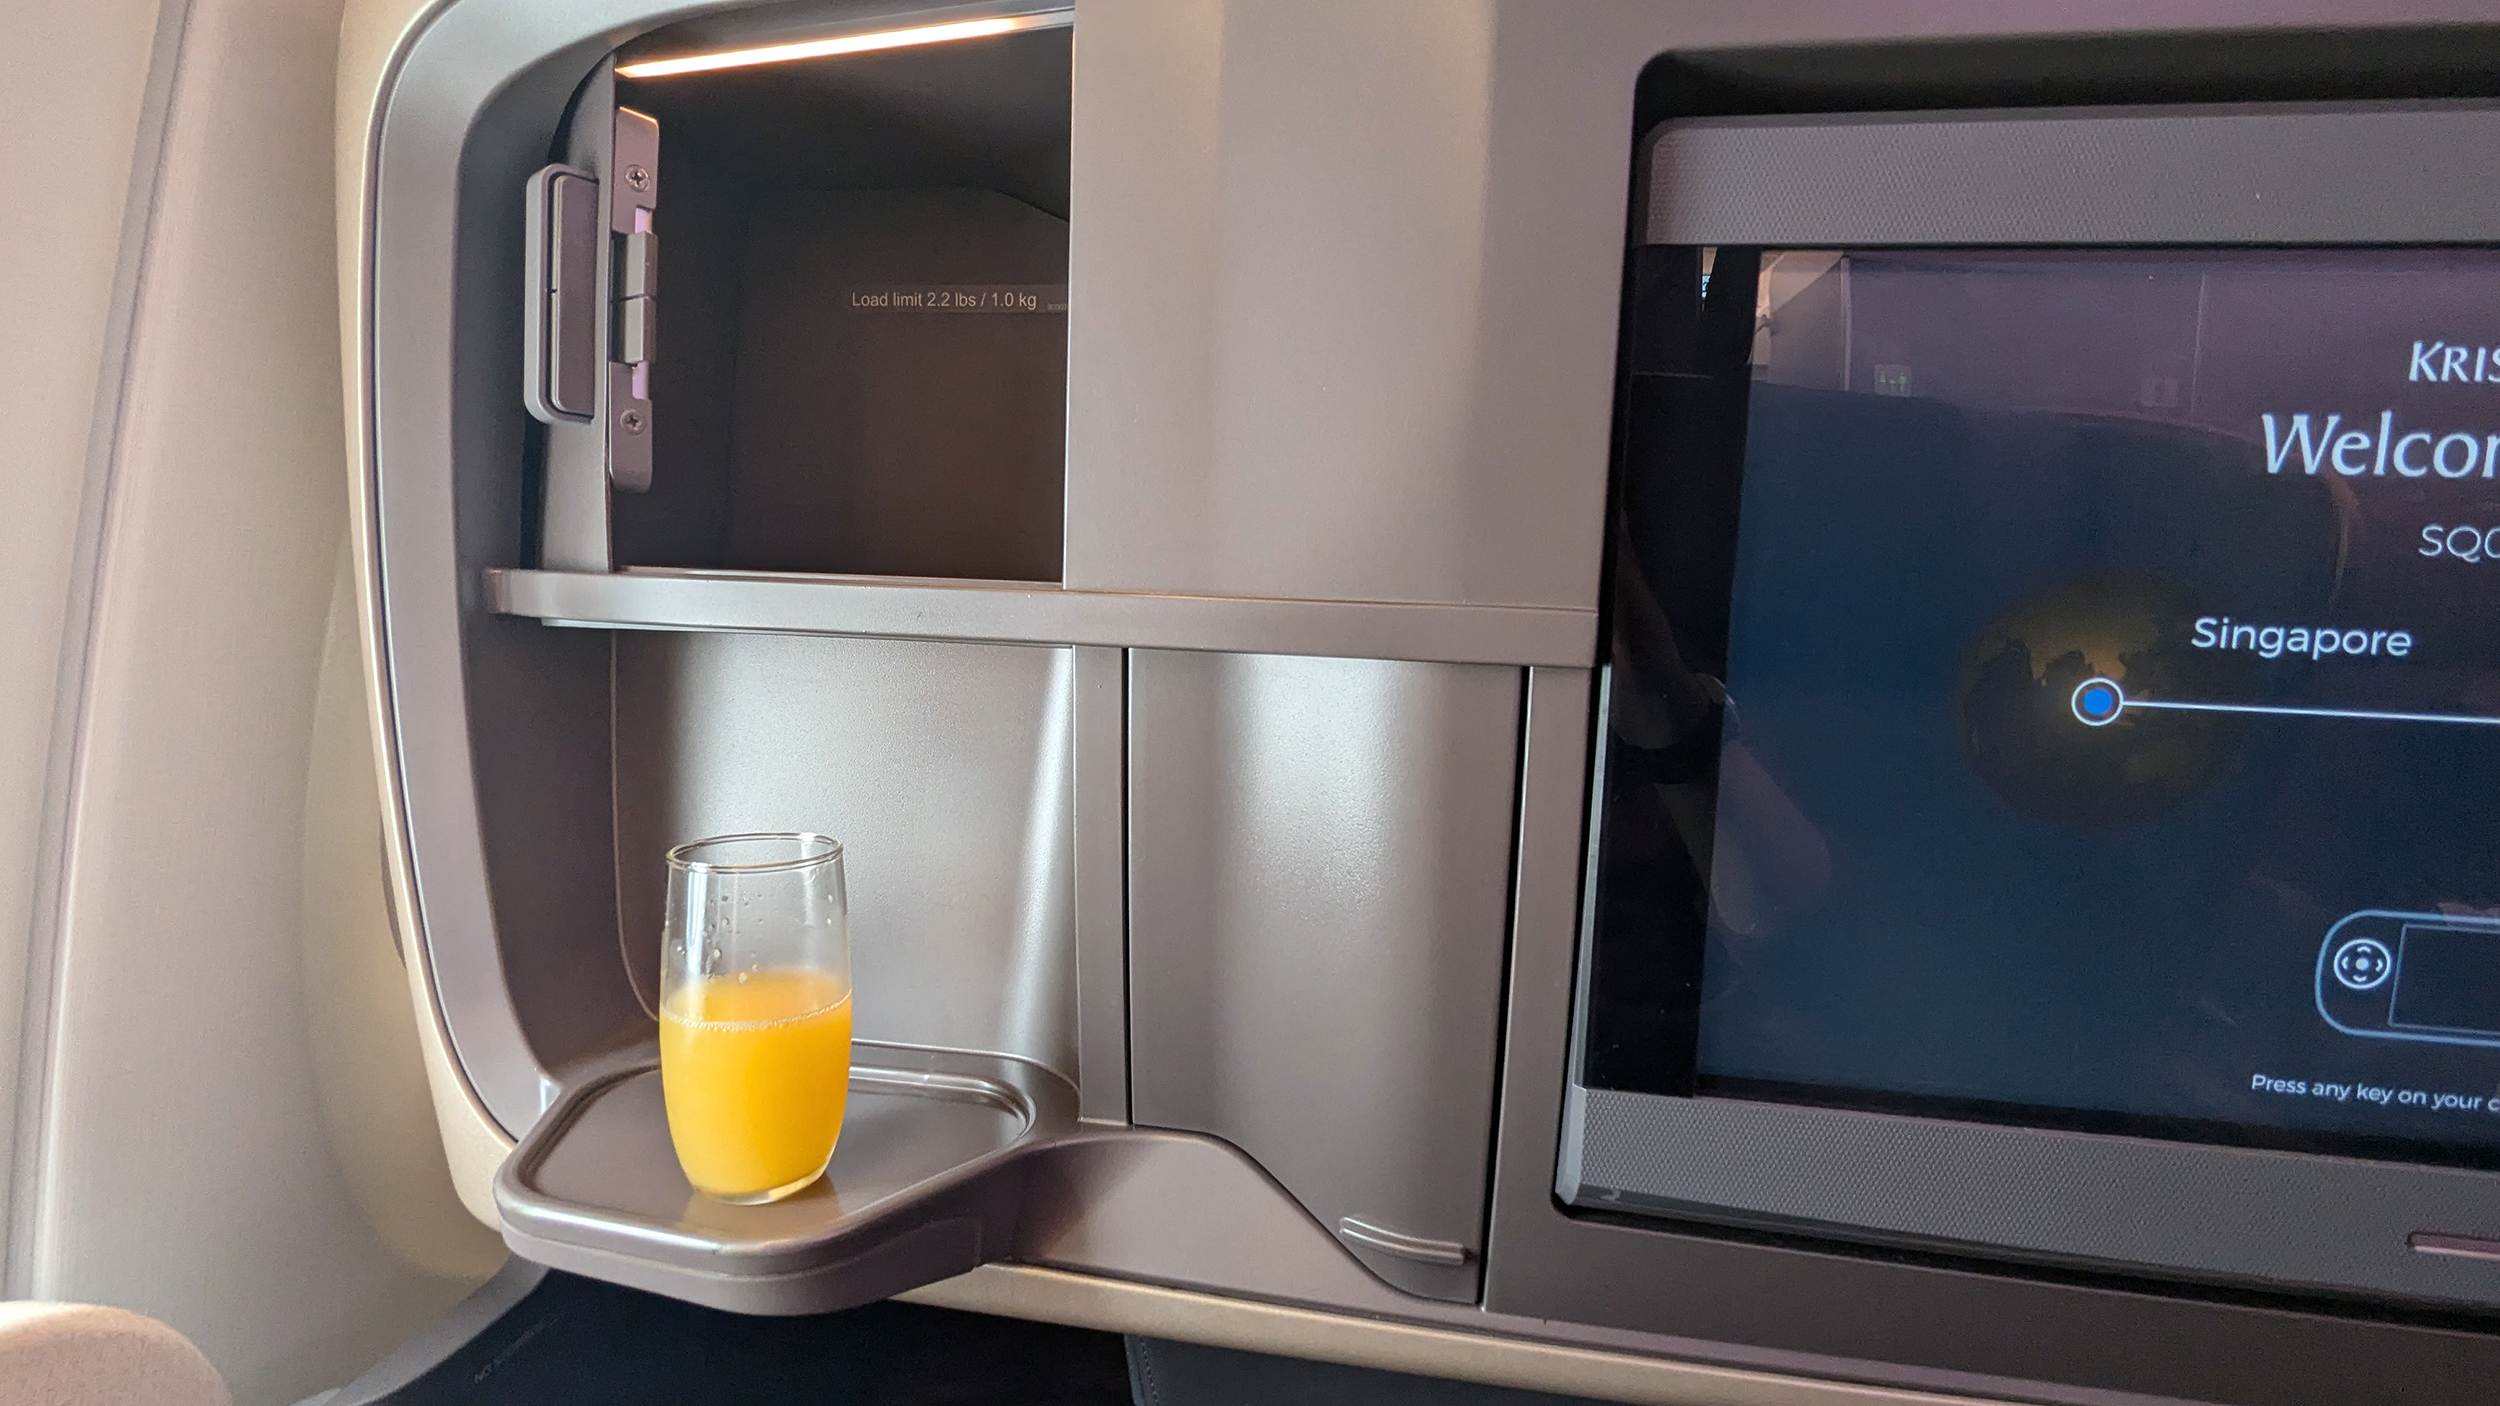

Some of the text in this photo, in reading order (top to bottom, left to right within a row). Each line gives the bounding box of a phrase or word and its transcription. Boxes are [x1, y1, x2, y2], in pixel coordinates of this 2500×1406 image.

[852, 292, 888, 307] Load
[893, 292, 923, 307] limit
[927, 292, 950, 307] 2.2
[955, 292, 976, 307] lbs
[980, 292, 987, 307] /
[992, 292, 1014, 307] 1.0
[1019, 292, 1037, 311] kg
[2191, 616, 2413, 661] Singapore
[2251, 1073, 2306, 1095] Press
[2311, 1082, 2350, 1101] any
[2356, 1083, 2393, 1105] key
[2397, 1089, 2427, 1106] on
[2430, 1092, 2483, 1111] your
